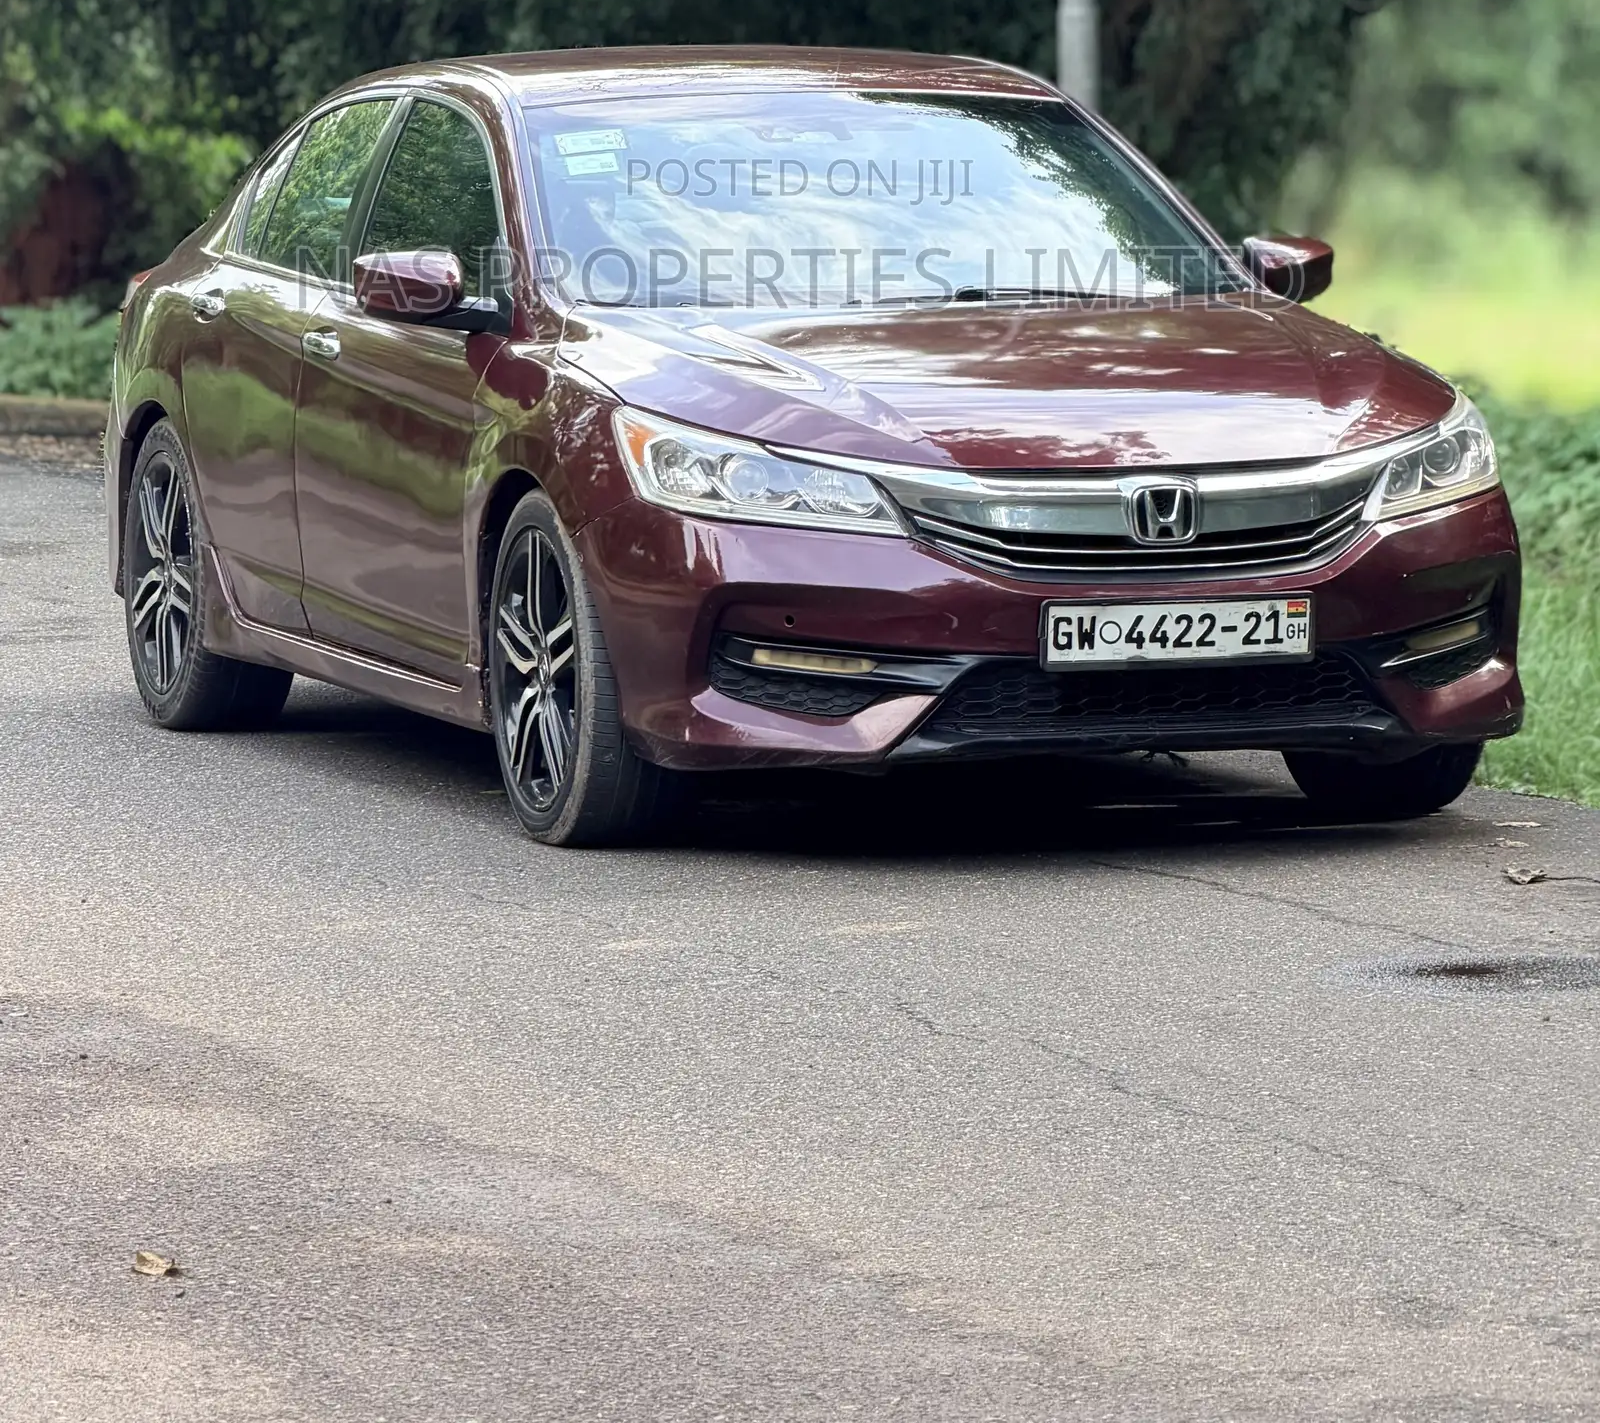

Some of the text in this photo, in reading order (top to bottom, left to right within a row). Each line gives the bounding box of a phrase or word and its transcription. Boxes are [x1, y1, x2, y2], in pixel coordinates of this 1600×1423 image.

[1052, 609, 1284, 651] GW 4422-21
[1286, 622, 1307, 640] GH
